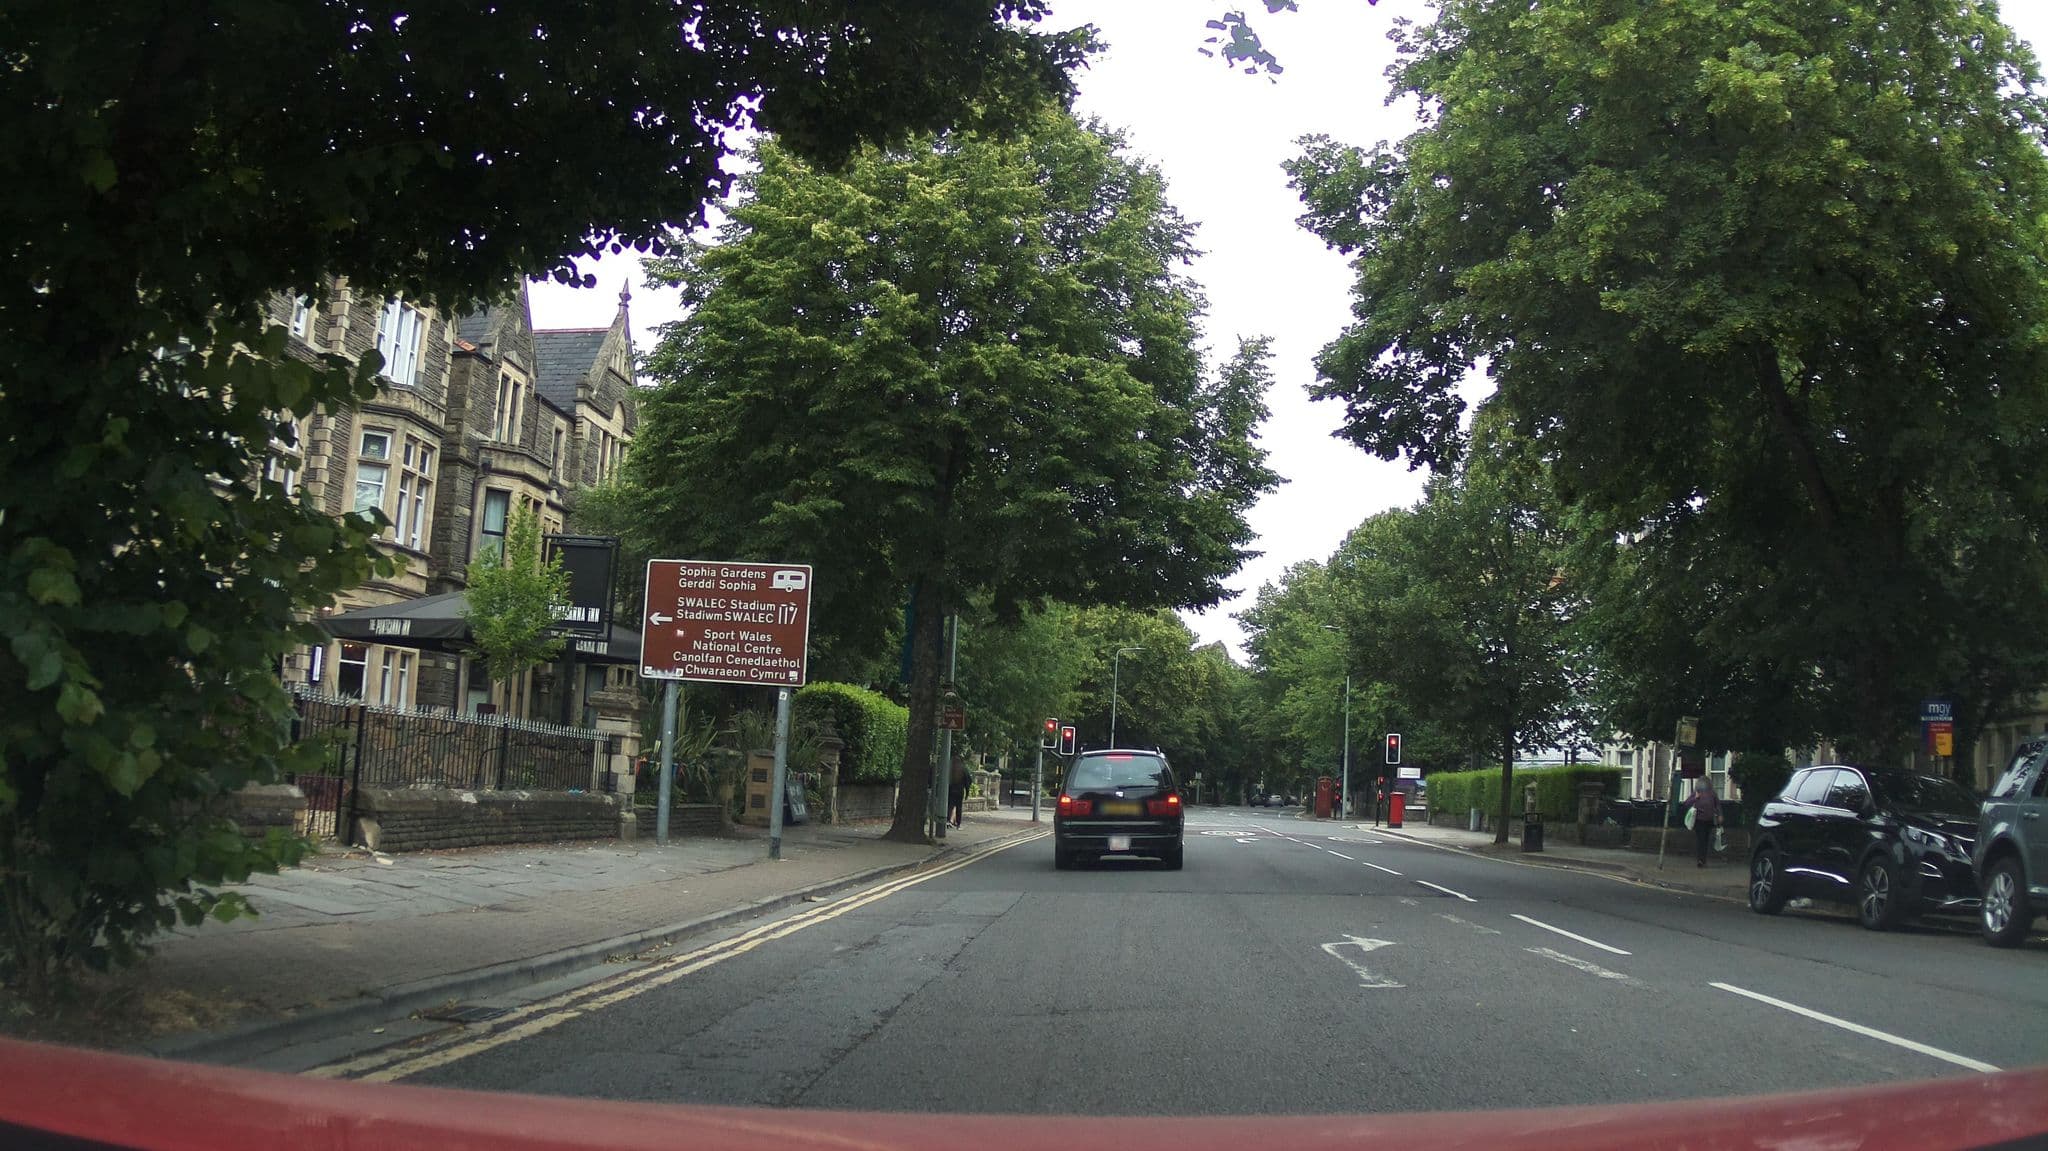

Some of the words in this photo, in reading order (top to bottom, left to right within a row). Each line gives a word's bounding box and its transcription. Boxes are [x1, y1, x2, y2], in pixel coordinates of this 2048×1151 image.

[679, 566, 717, 578] Sophia
[720, 567, 767, 579] Gardens
[678, 578, 715, 589] Gerddi
[719, 580, 757, 592] Sophia
[677, 597, 727, 609] SWALEC
[730, 599, 776, 611] Stadium
[676, 609, 723, 621] Stadiwm
[724, 611, 774, 624] SWALEC
[704, 629, 735, 641] Sport
[739, 630, 772, 642] Wales
[693, 641, 740, 652] National
[744, 643, 782, 655] Centre
[673, 651, 722, 663] Canolfan
[726, 654, 800, 668] Cenedlaethol
[685, 664, 746, 677] Chwaraeon
[750, 669, 786, 681] Cymru
